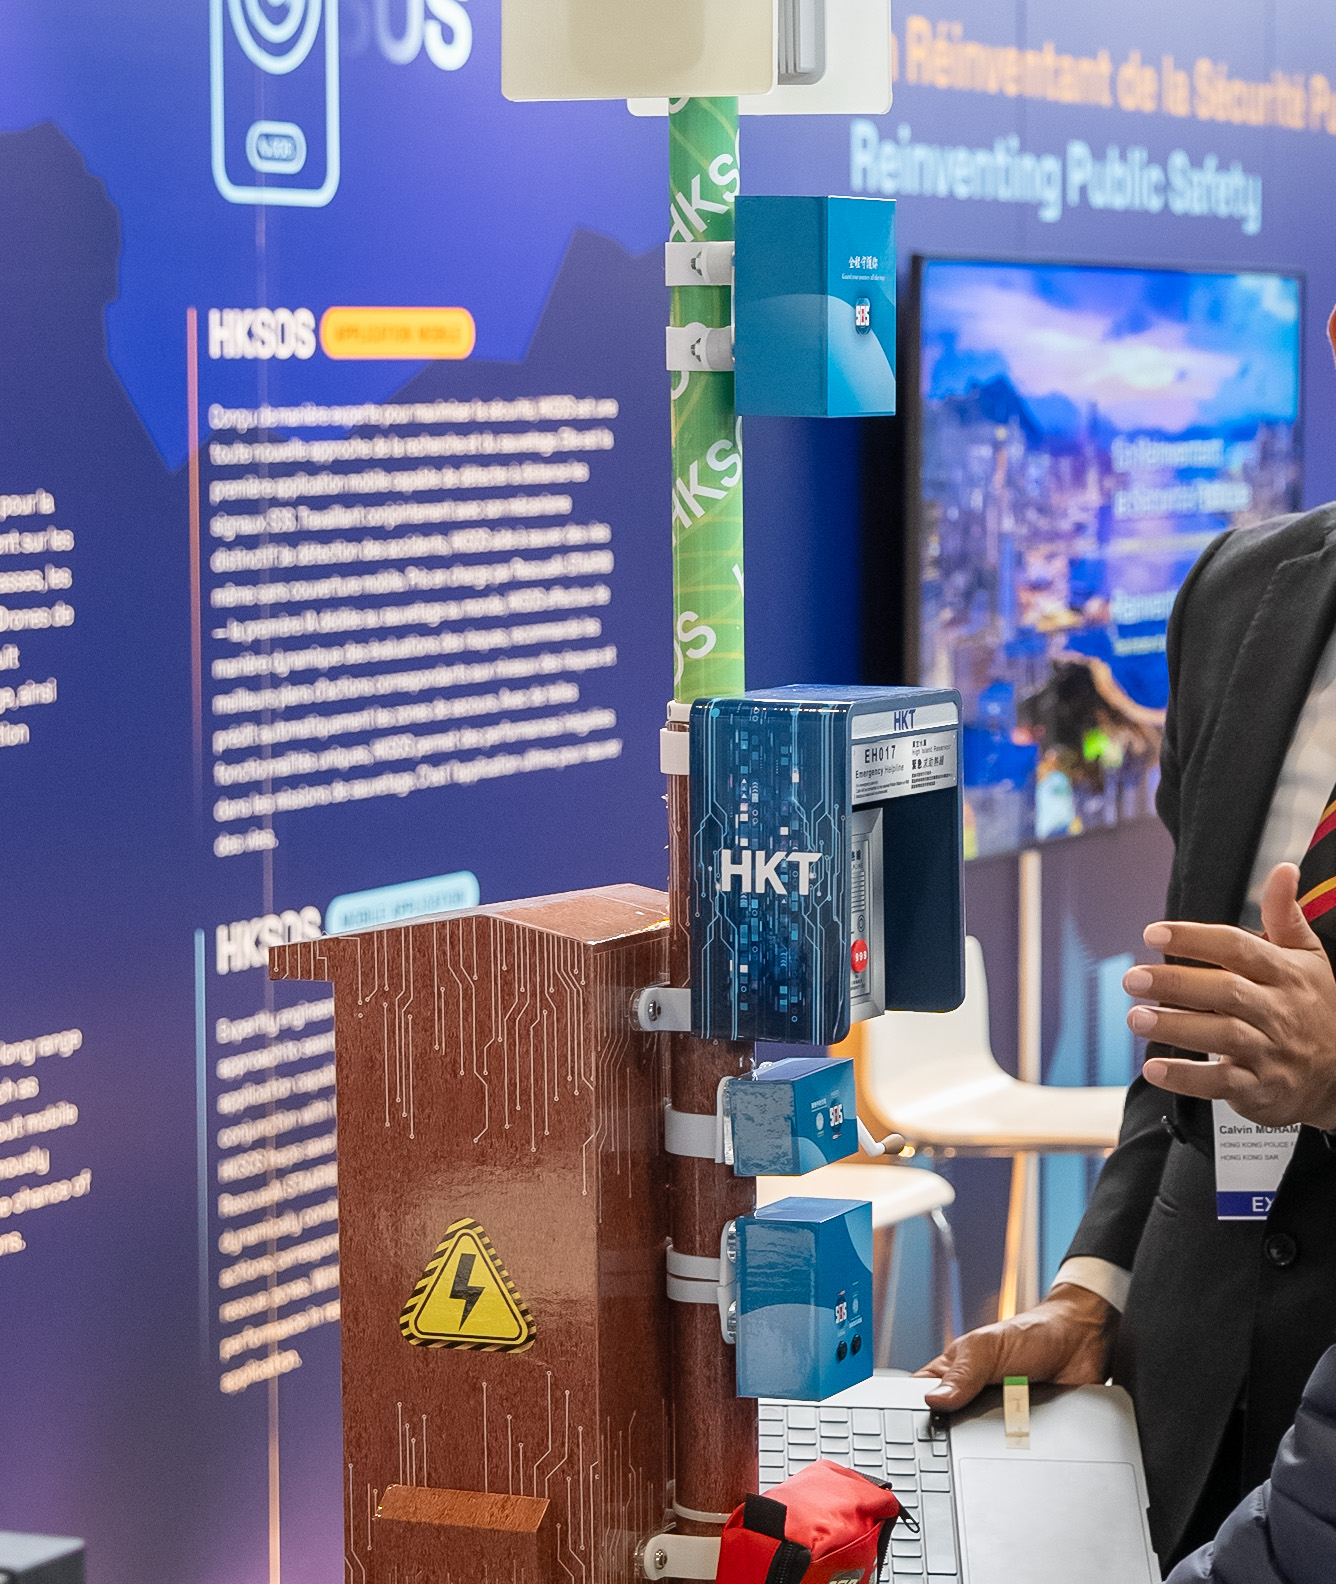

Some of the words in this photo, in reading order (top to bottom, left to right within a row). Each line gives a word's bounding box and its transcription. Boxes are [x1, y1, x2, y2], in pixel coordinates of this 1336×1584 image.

[849, 118, 1062, 223] Reinventing
[1066, 139, 1166, 215] Public
[1167, 149, 1263, 236] Safety
[208, 307, 317, 360] HKSOS
[893, 708, 917, 731] HKT
[864, 744, 896, 764] EH017
[855, 767, 883, 779] Emergency
[720, 848, 823, 896] HKT
[1219, 1125, 1253, 1134] Calvin
